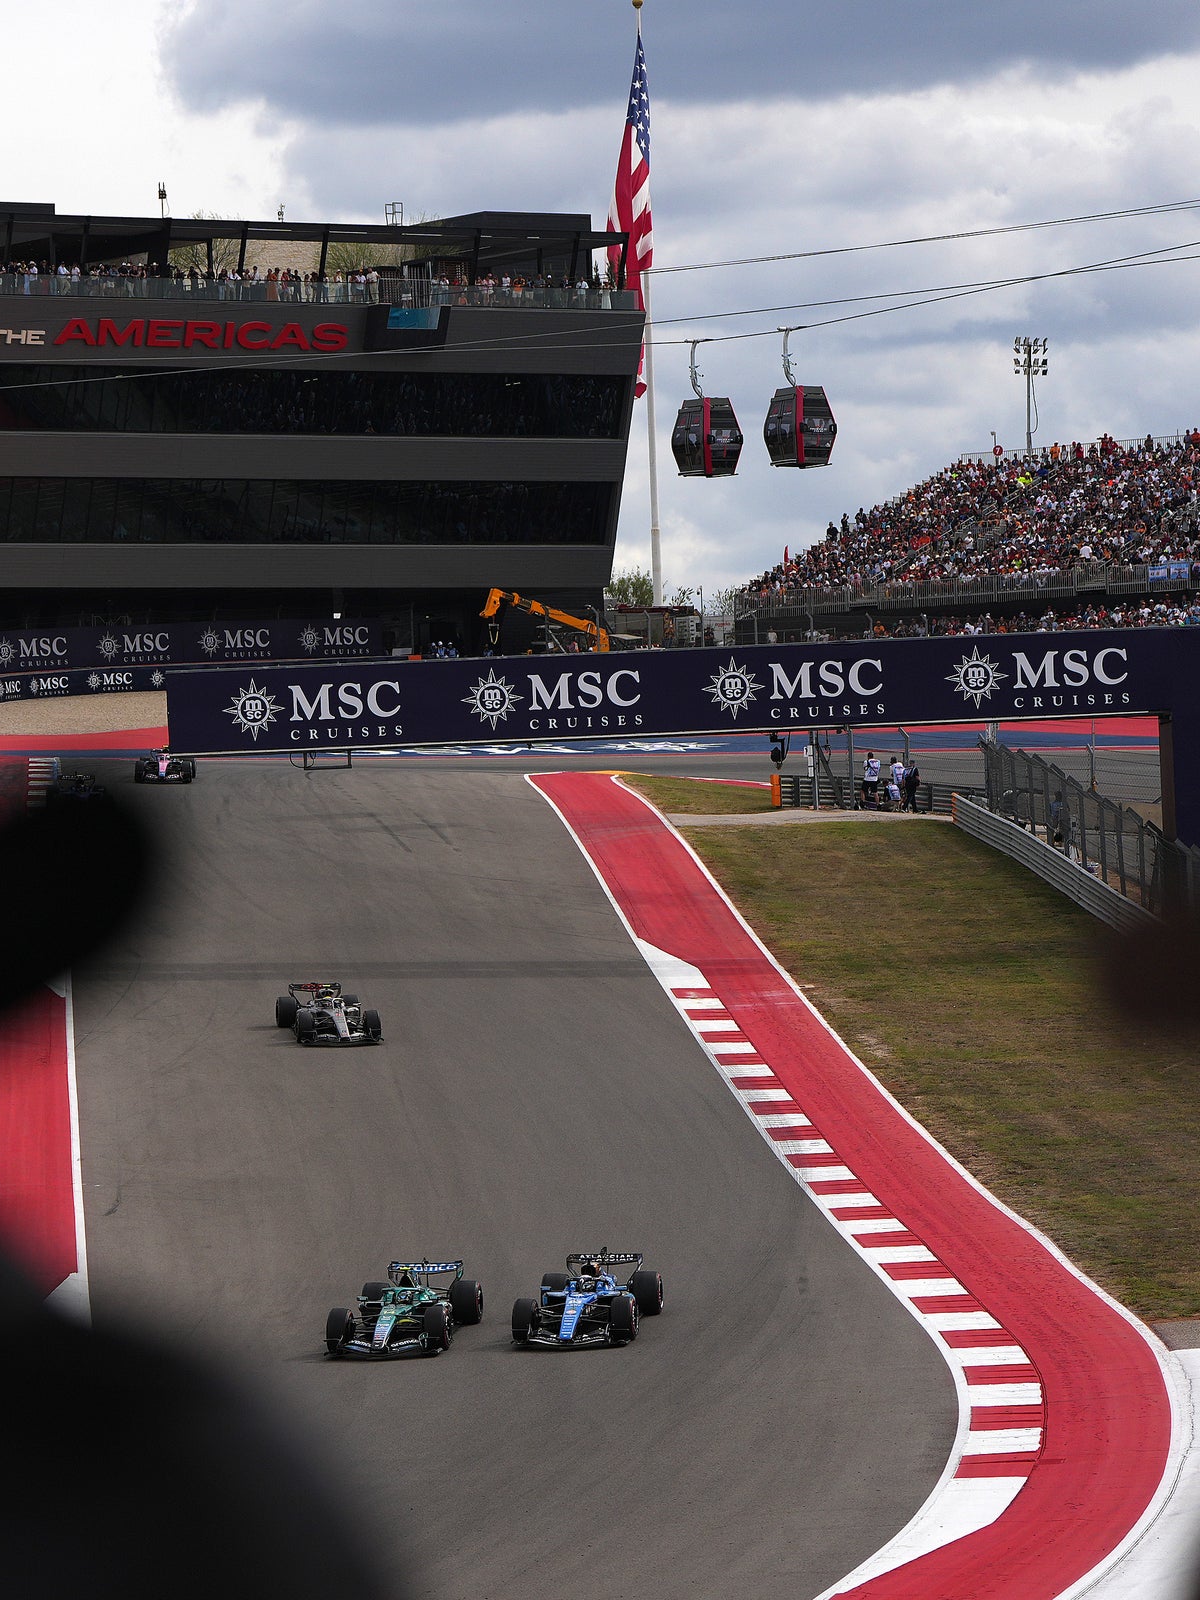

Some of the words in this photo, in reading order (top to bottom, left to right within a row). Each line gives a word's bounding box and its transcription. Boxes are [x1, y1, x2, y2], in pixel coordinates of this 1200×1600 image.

[53, 317, 349, 352] AMERICAS
[122, 632, 170, 653] MSC
[224, 628, 270, 648] MSC
[323, 626, 369, 646] MSC
[18, 636, 68, 658] MSC
[225, 650, 271, 658] CRUISES
[324, 647, 370, 655] CRUISES
[20, 658, 69, 668] CRUISES
[123, 654, 171, 663] CRUISES
[1011, 647, 1129, 690] MSC
[39, 676, 69, 690] MSC
[103, 672, 133, 685] MSC
[768, 658, 883, 700] MSC
[5, 680, 21, 694] MSC
[526, 669, 641, 711] MSC
[288, 681, 401, 721] MSC
[1014, 692, 1131, 708] CRUISES
[770, 702, 885, 719] CRUISES
[530, 714, 643, 730] CRUISES
[290, 725, 403, 741] CRUISES
